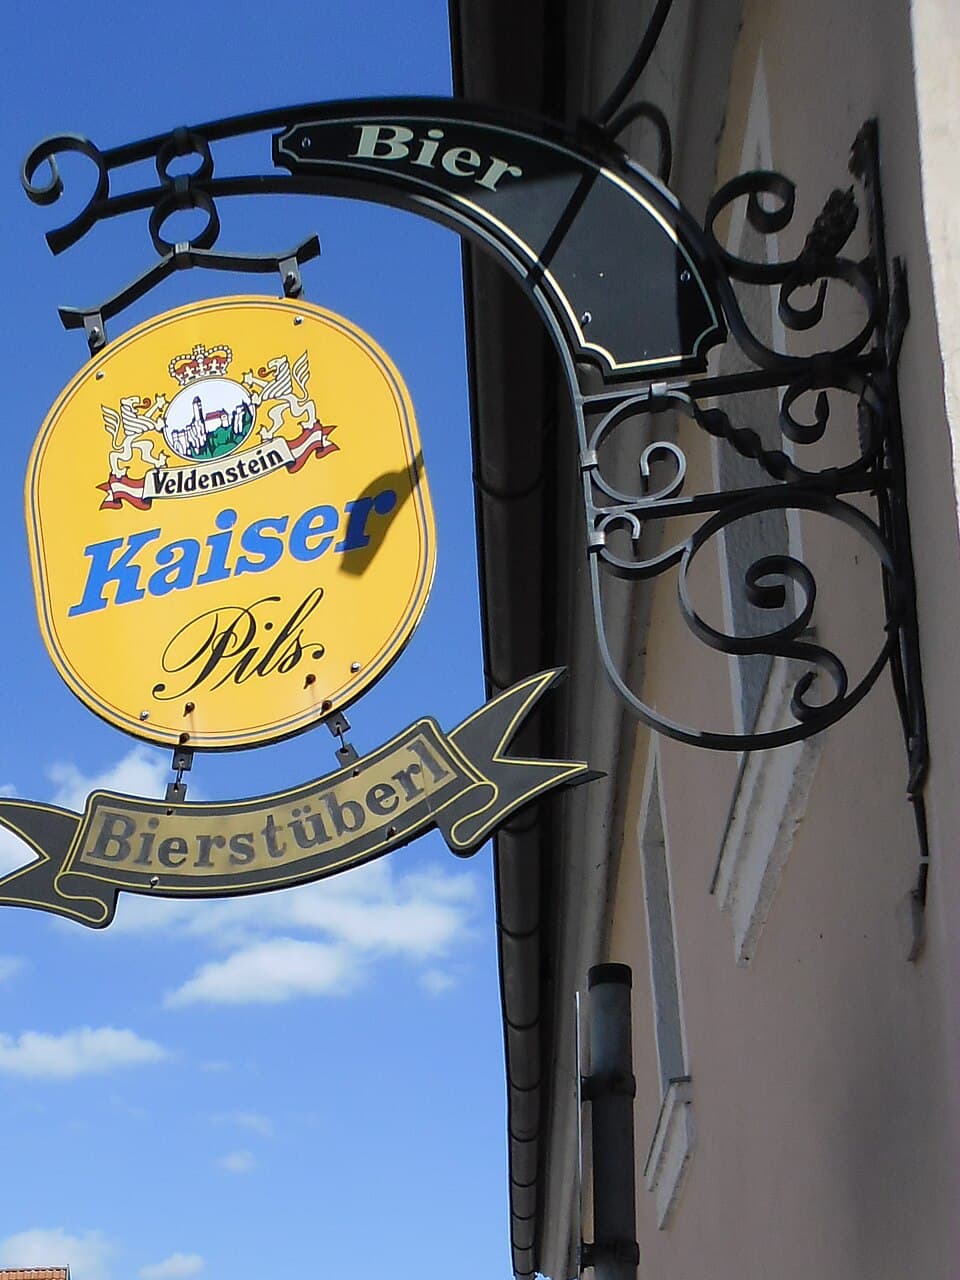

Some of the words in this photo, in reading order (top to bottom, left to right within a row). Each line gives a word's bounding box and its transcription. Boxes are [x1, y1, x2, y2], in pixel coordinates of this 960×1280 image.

[347, 124, 523, 192] Bier
[151, 446, 283, 496] Veldenstein
[68, 489, 397, 618] Kaiser
[152, 587, 325, 701] Pils
[85, 734, 456, 869] Bierstüberl
